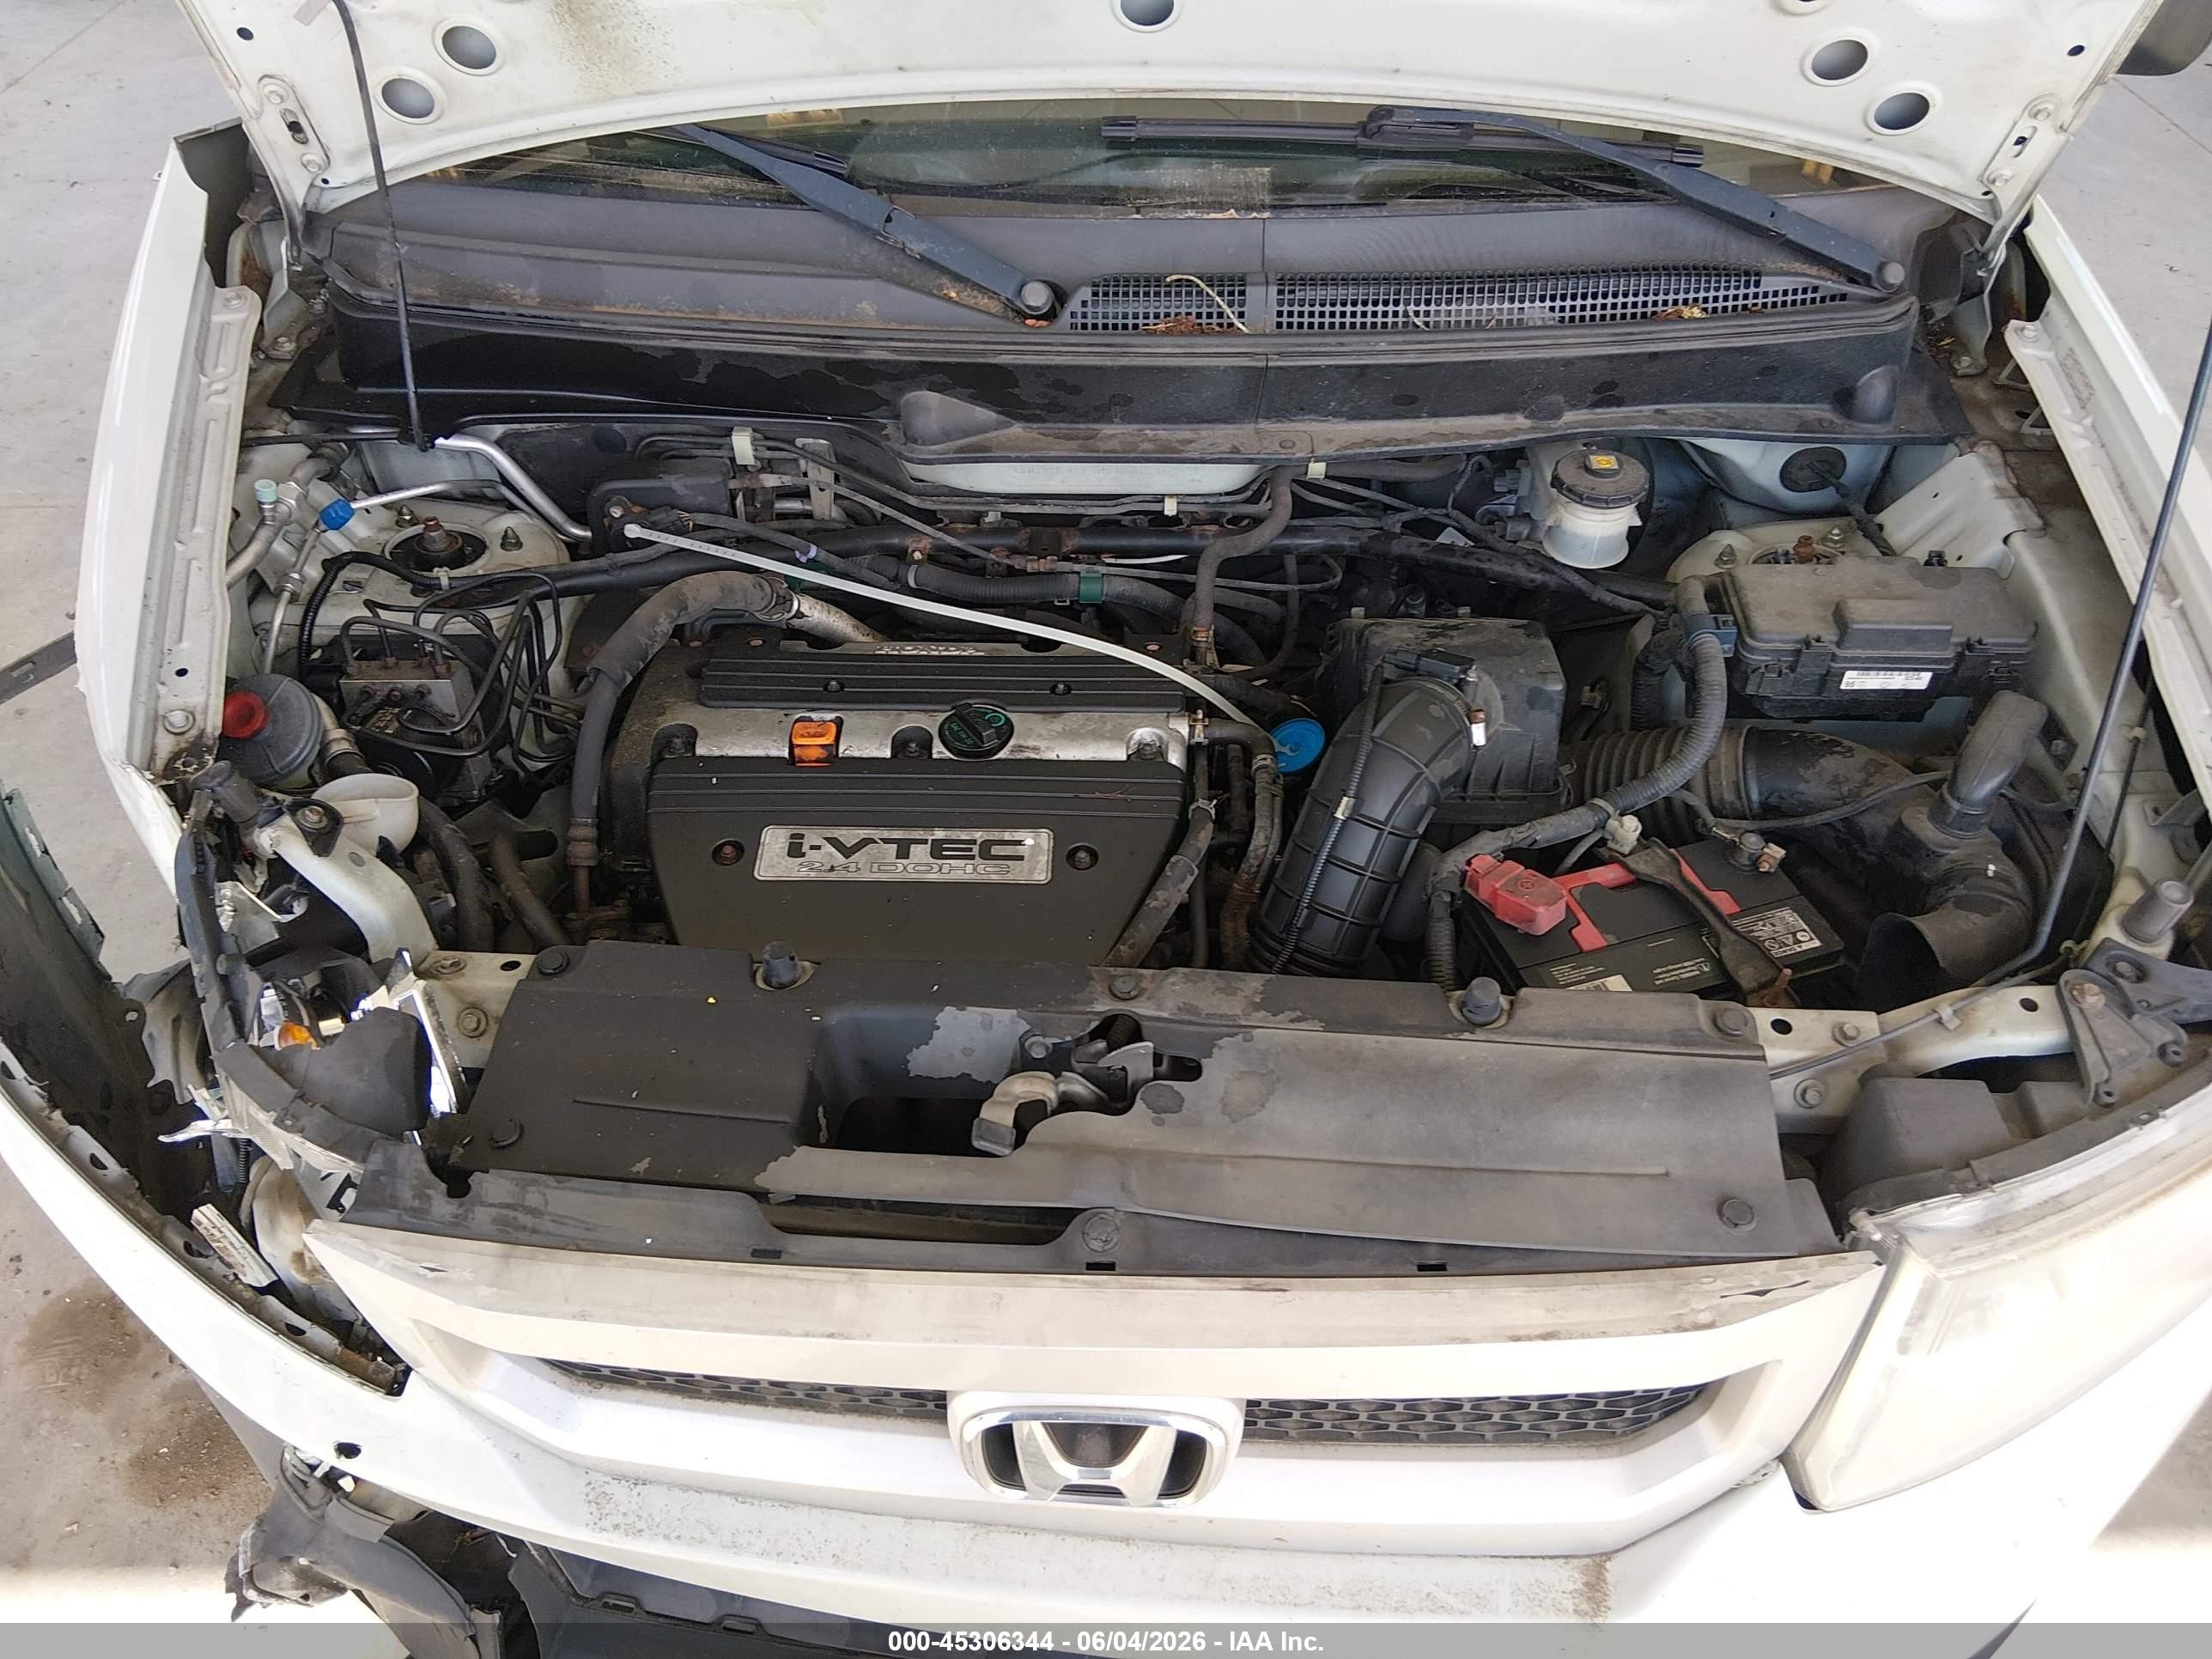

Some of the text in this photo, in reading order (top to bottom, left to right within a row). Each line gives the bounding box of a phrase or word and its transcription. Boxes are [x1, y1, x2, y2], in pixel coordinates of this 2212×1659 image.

[786, 833, 1026, 861] i-VTEC
[797, 861, 1011, 875] 2.4 DOHC
